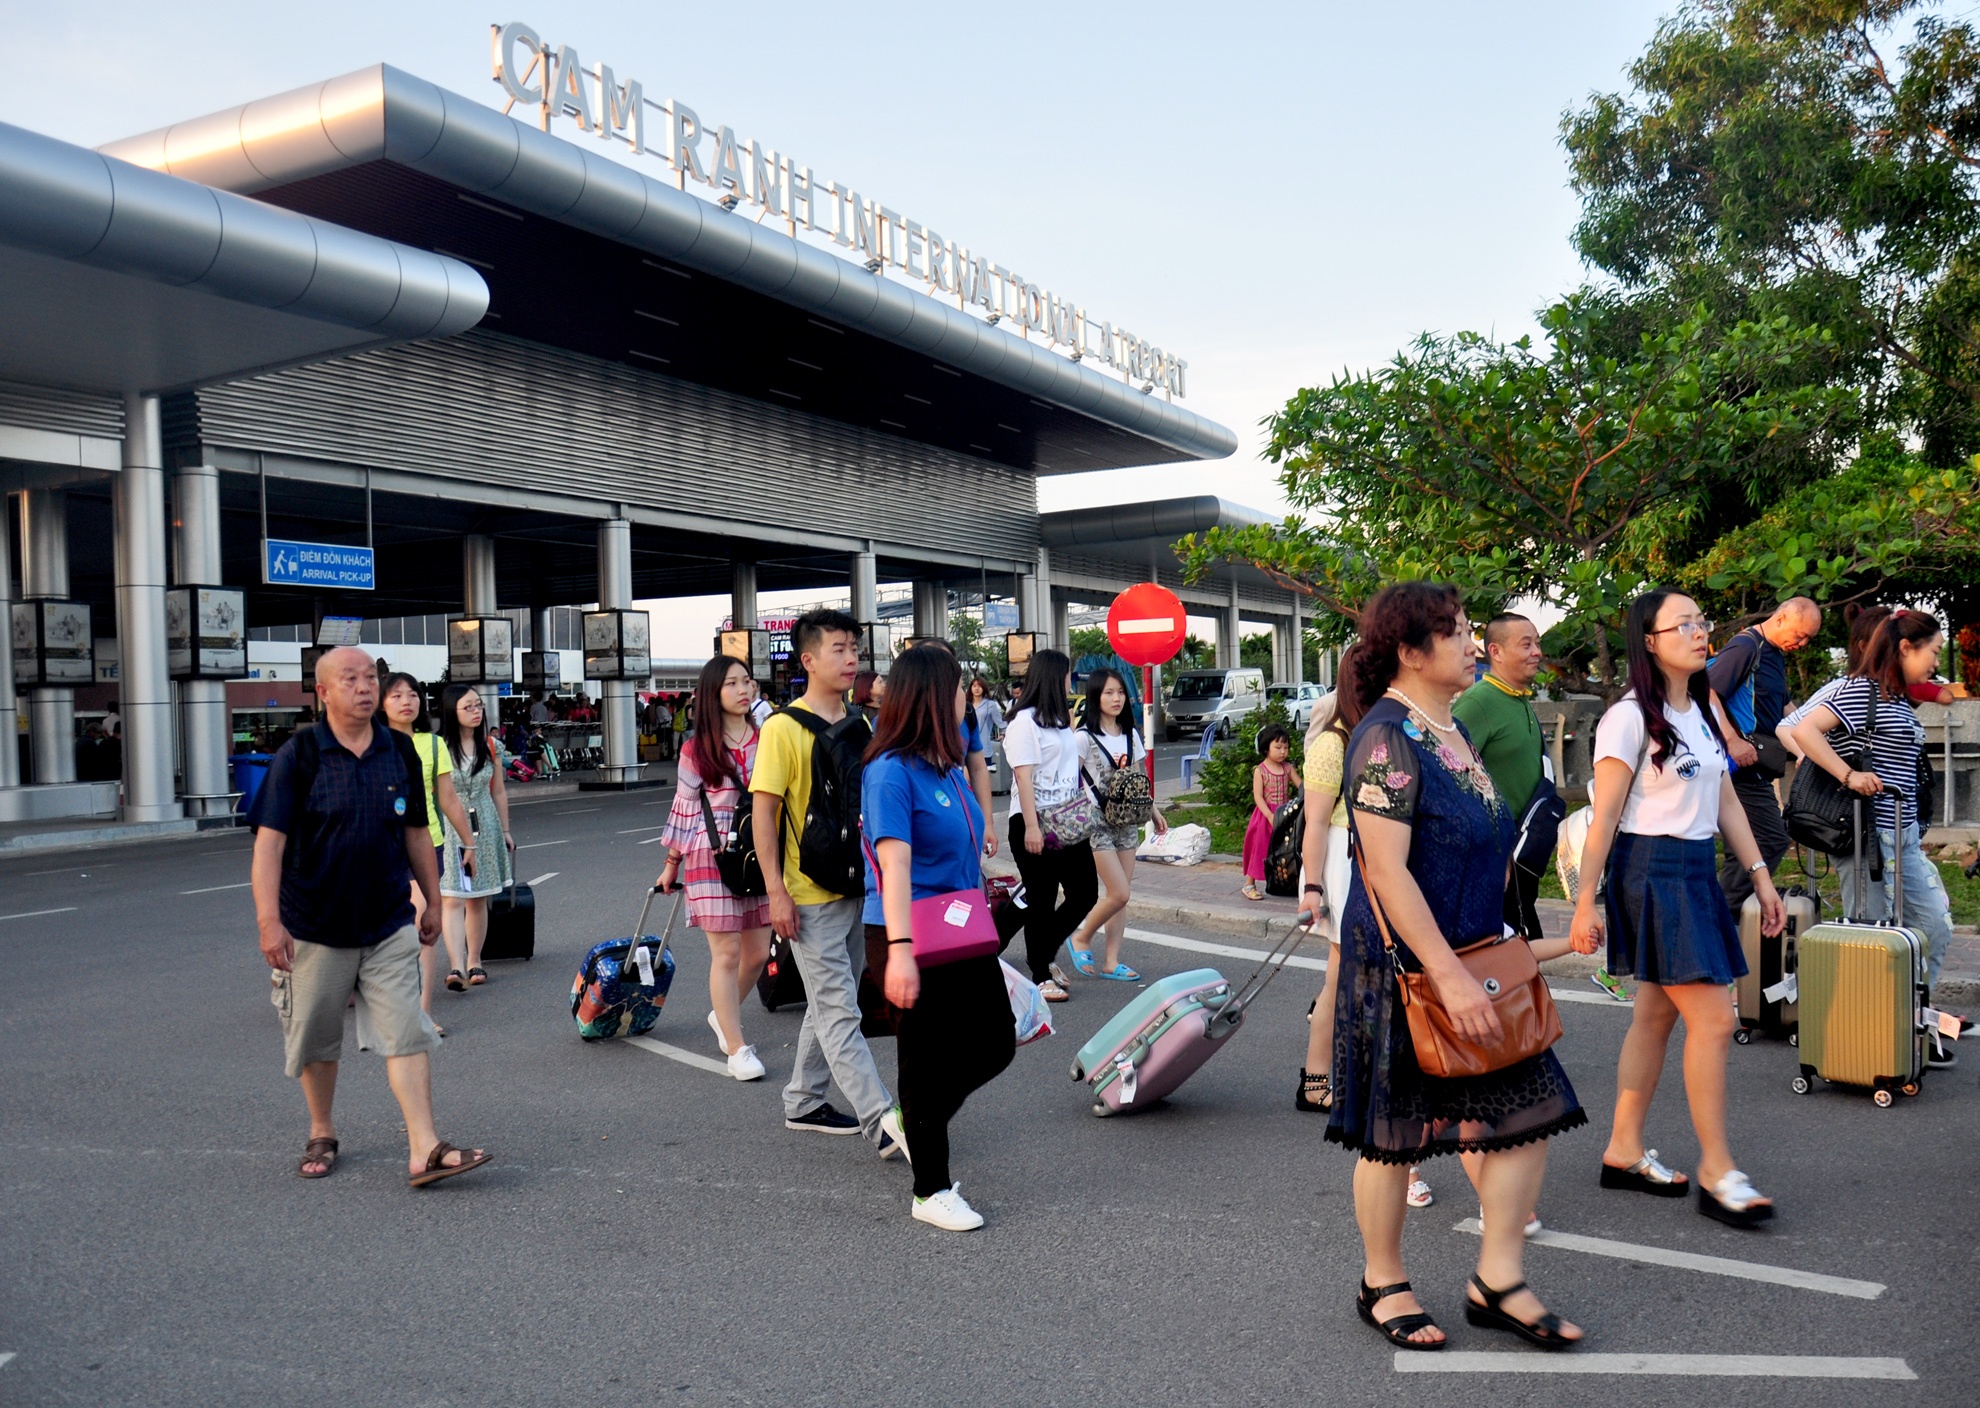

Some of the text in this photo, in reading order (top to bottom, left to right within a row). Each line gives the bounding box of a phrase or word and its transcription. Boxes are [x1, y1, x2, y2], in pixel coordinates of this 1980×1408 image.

[493, 21, 1188, 398] CAM RANH INTERNATIONAL AIRPORT
[343, 553, 371, 567] KHÁCH
[302, 569, 372, 582] ARRIVAL PICK-UP
